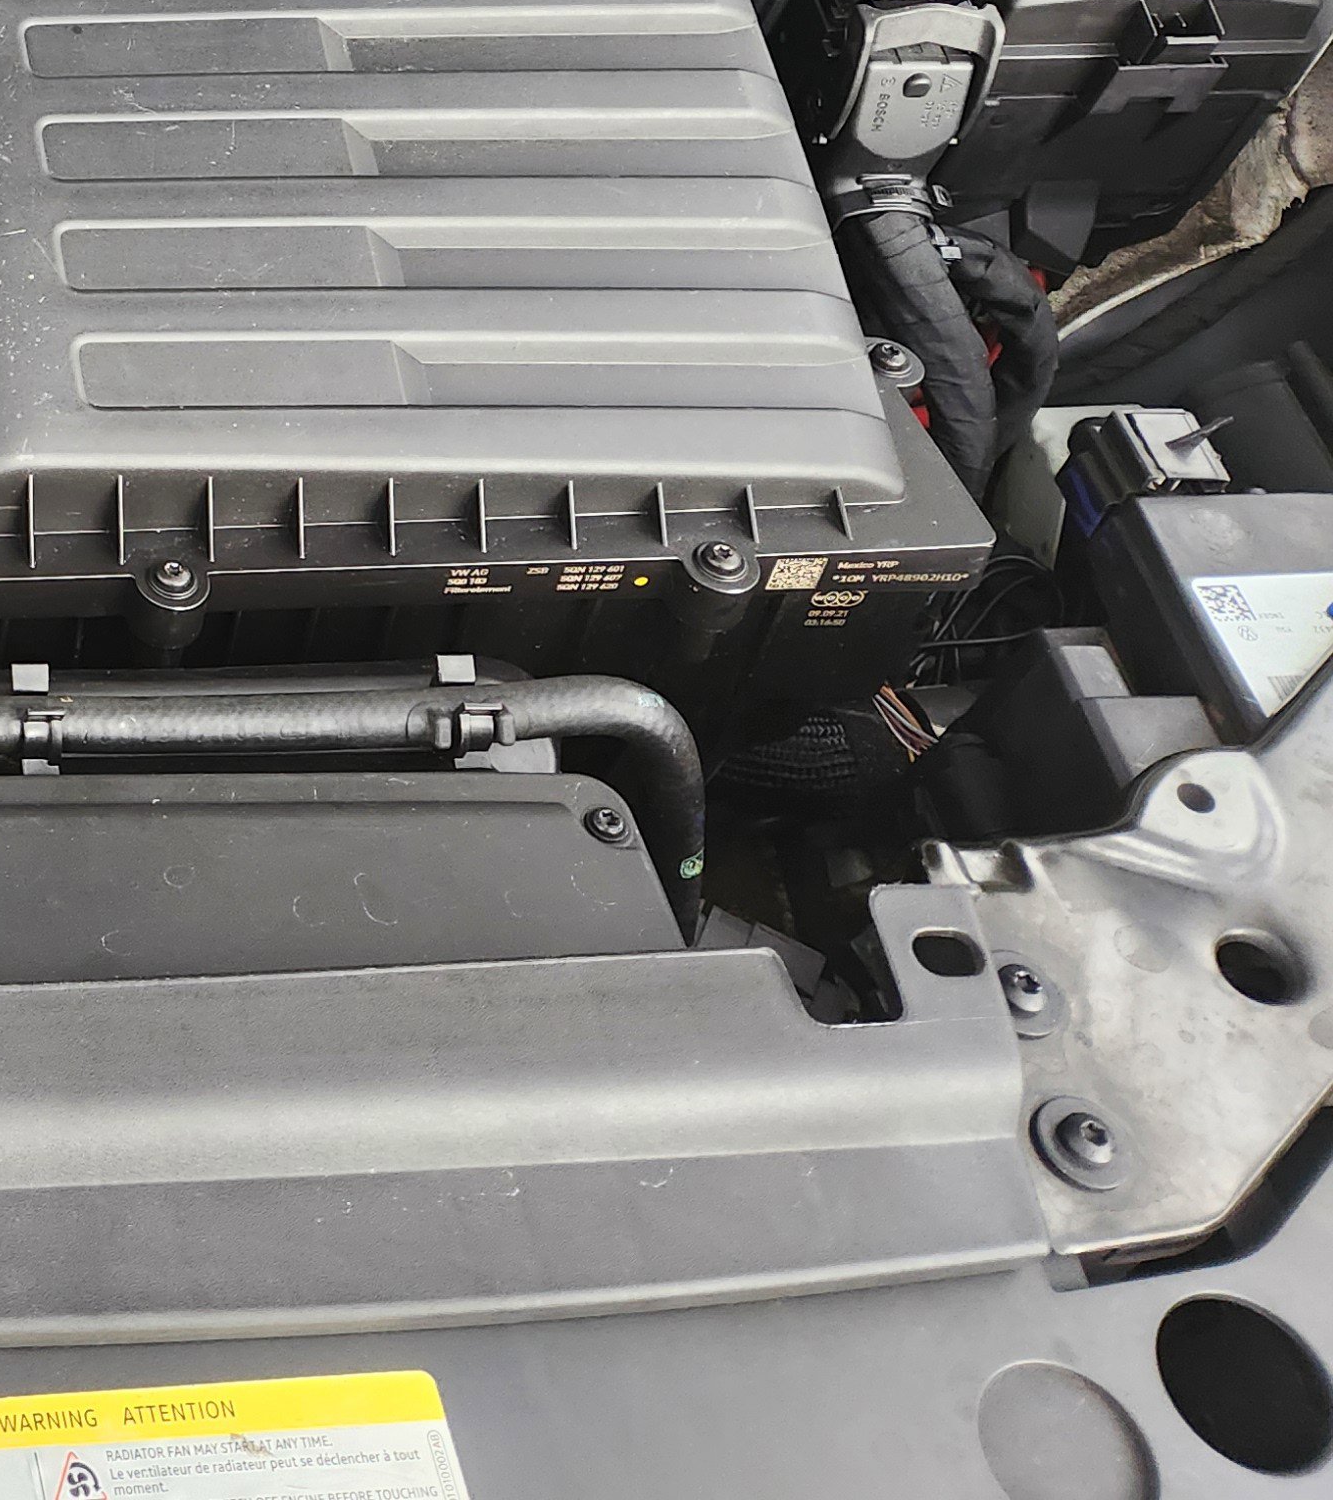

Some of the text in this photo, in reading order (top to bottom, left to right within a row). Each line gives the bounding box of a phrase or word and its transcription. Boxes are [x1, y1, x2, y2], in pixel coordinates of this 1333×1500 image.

[871, 93, 891, 133] BOSCH
[123, 1399, 236, 1426] ATTENTION
[106, 1435, 334, 1462] RADIATOR FAN MAY START AT ANY TIME.
[109, 1467, 125, 1481] Le
[195, 1461, 210, 1474] de
[213, 1458, 267, 1474] radiateur
[270, 1455, 297, 1472] peut
[300, 1455, 314, 1467] se
[316, 1450, 381, 1467] déclencher
[383, 1449, 392, 1462] à
[393, 1449, 421, 1462] tout
[114, 1481, 169, 1496] moment.
